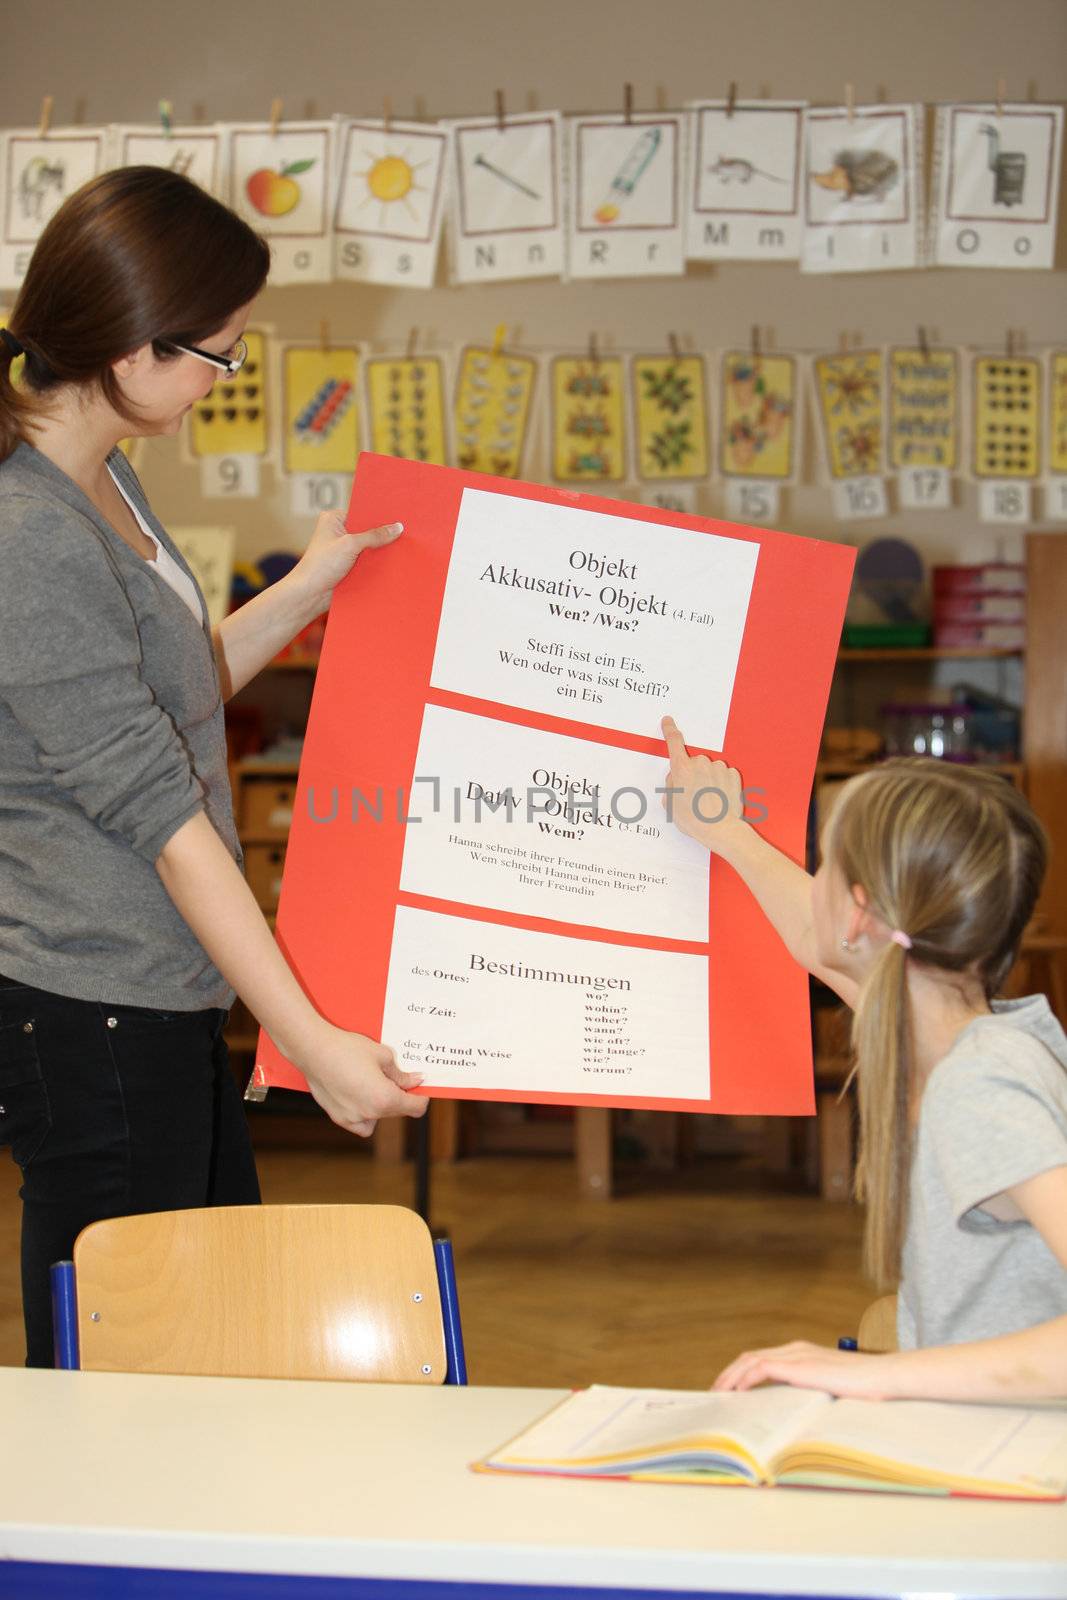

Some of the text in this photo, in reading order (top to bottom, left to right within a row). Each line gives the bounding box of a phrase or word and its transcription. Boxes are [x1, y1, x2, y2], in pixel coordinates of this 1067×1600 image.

[703, 222, 784, 248] M m
[956, 229, 1032, 256] O o
[342, 242, 412, 274] S s
[475, 244, 544, 268] N n
[590, 240, 658, 264] R r
[218, 458, 241, 492] 9
[912, 470, 940, 497] 17
[307, 477, 339, 509] 10
[740, 486, 769, 518] 15
[845, 482, 877, 511] 16
[993, 486, 1023, 517] 18
[569, 550, 638, 579] Objekt
[479, 563, 714, 627] Akkusativ- Objekt (4. Fall)
[548, 603, 639, 632] Wen? /Was?
[527, 638, 645, 674] Steffi isst ein Eis.
[499, 650, 670, 698] Wen oder was isst Steffi?
[556, 684, 604, 704] ein Eis
[532, 768, 602, 798] Objekt
[466, 781, 522, 809] Dativ
[544, 798, 613, 828] Objekt
[636, 823, 661, 839] Fall)
[538, 821, 585, 841] Wem?
[448, 834, 669, 886] Hanna schreibt ihrer Freundin einen Brief.
[470, 851, 647, 893] Wem schreibt Hanna einen Brief?
[518, 874, 595, 897] Ihrer Freundin
[411, 965, 470, 984] des Ortes:
[469, 953, 632, 991] Bestimmungen
[584, 1005, 627, 1014] wohin?
[585, 993, 609, 1001] wo?
[407, 1003, 456, 1018] der Zeit:
[584, 1016, 628, 1025] woher?
[584, 1026, 623, 1035] wann?
[584, 1036, 604, 1044] wie
[402, 1051, 477, 1067] des Grundes
[403, 1039, 513, 1059] der Art und Weise
[583, 1046, 646, 1057] wie lange?
[583, 1056, 610, 1064] wie?
[583, 1066, 632, 1075] warum?
